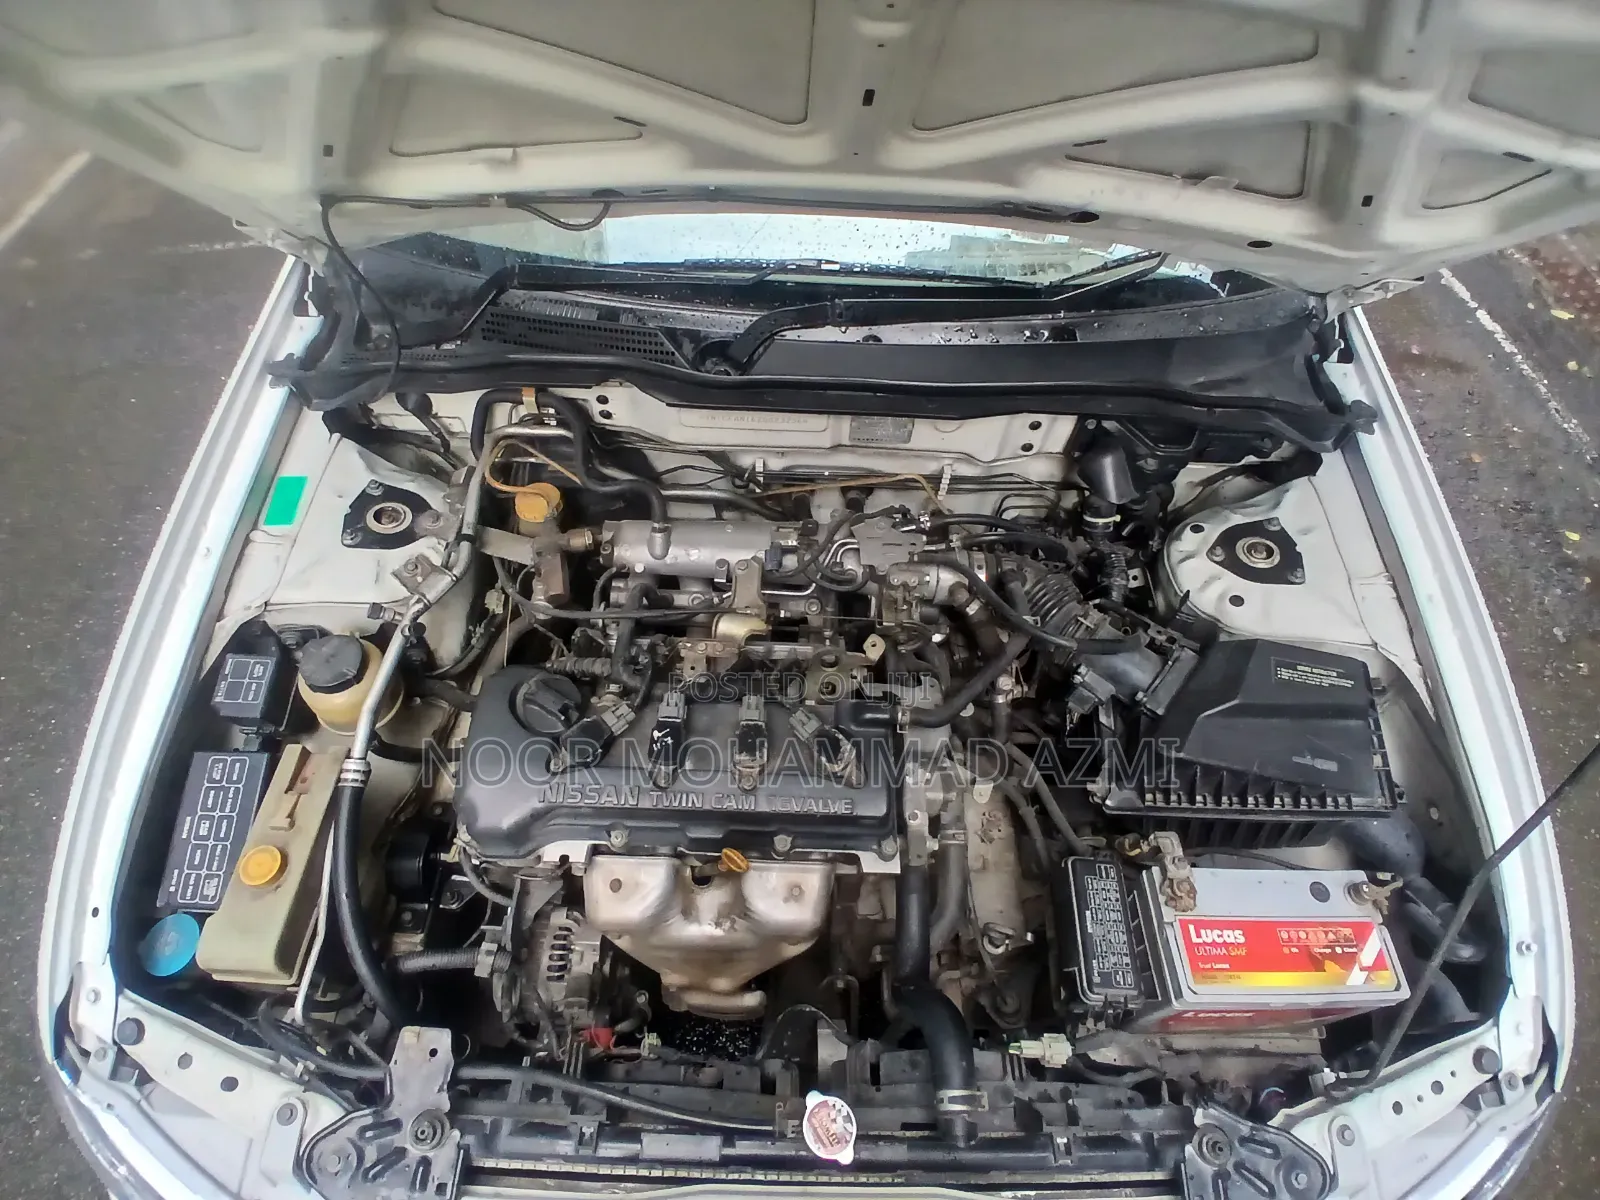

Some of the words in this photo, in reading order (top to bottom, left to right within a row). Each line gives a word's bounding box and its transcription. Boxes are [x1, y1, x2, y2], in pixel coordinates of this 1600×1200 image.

[538, 784, 641, 807] NISSAN
[649, 790, 704, 810] TWIN
[711, 793, 758, 812] CAM
[1188, 924, 1246, 944] Lucas
[1194, 945, 1229, 956] ULTIMA
